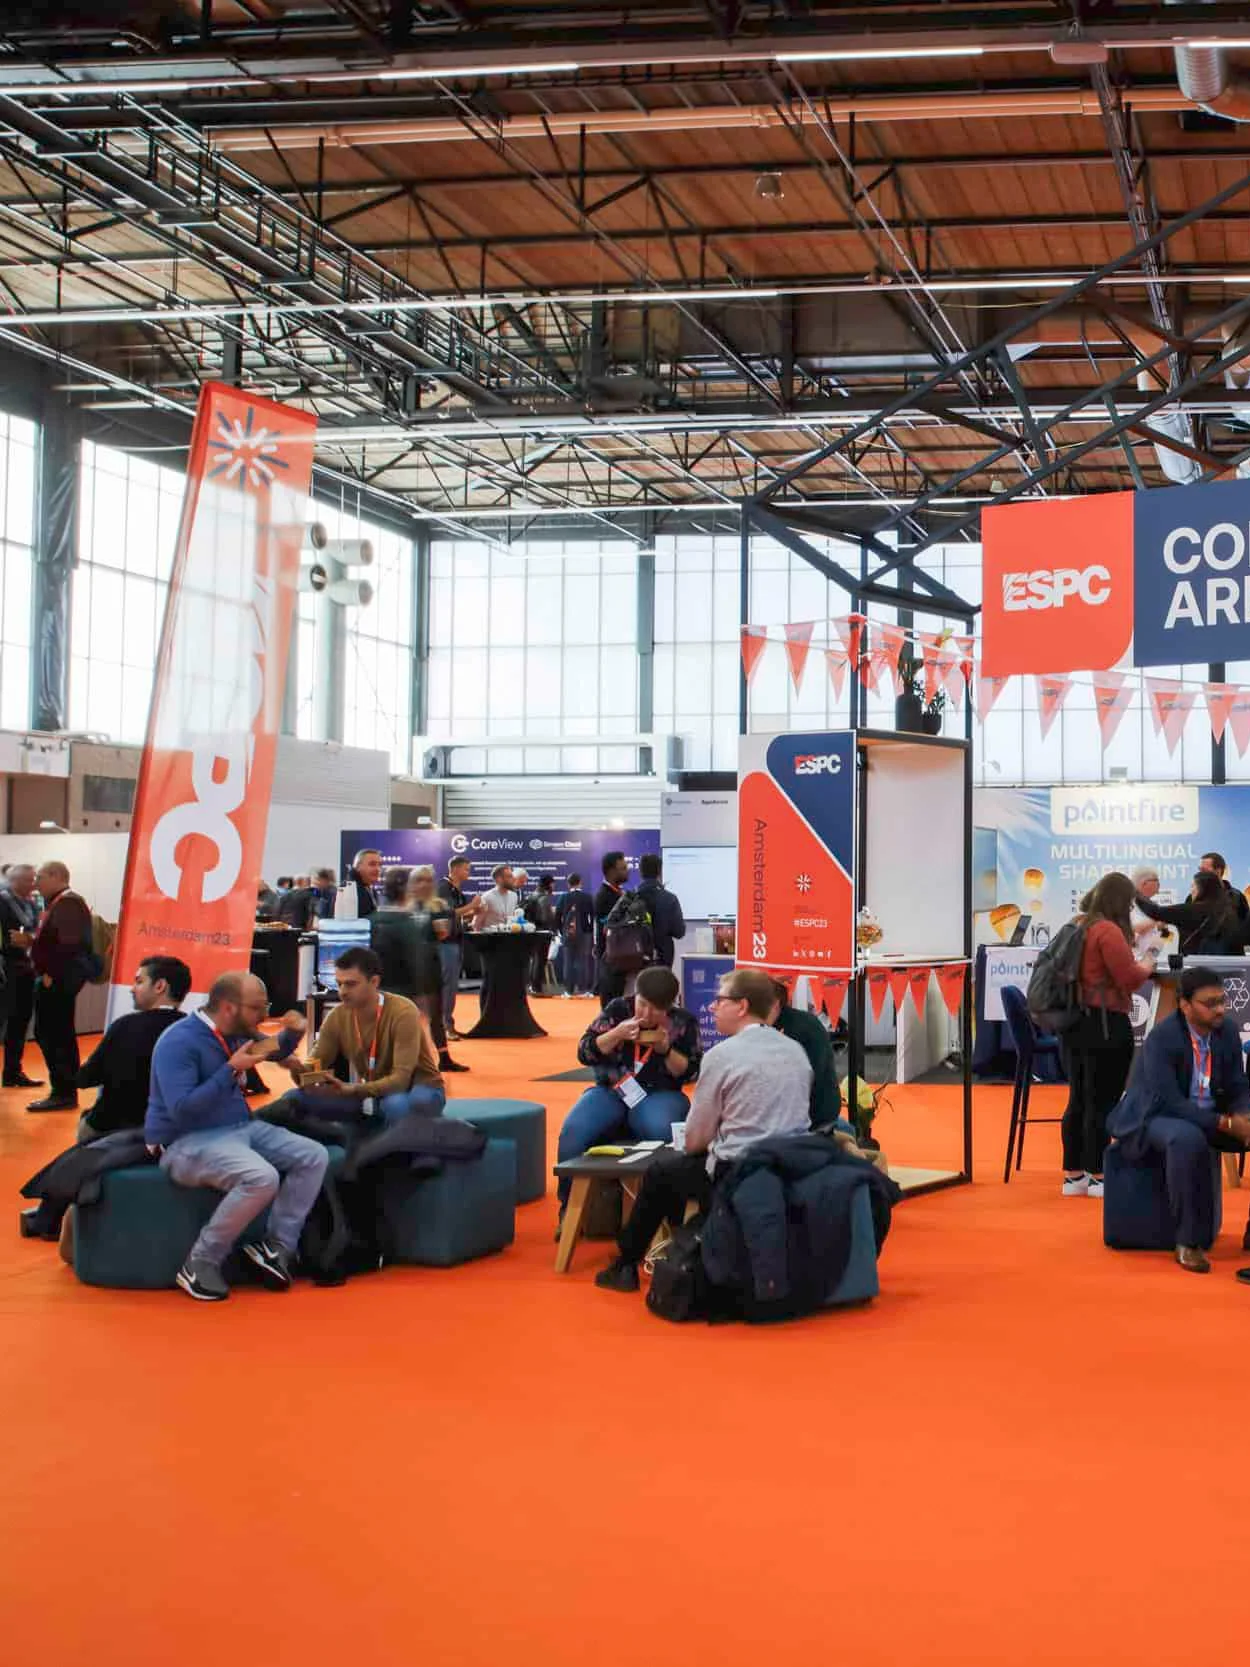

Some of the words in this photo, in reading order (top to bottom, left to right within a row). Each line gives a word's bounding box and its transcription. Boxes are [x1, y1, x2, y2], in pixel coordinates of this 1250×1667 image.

[1002, 565, 1111, 612] ESPC
[794, 754, 841, 774] ESPC
[1064, 798, 1185, 828] pointfire
[471, 838, 524, 850] CoreView
[1051, 844, 1198, 859] MULTILINGUAL
[752, 818, 768, 959] Amsterdam23
